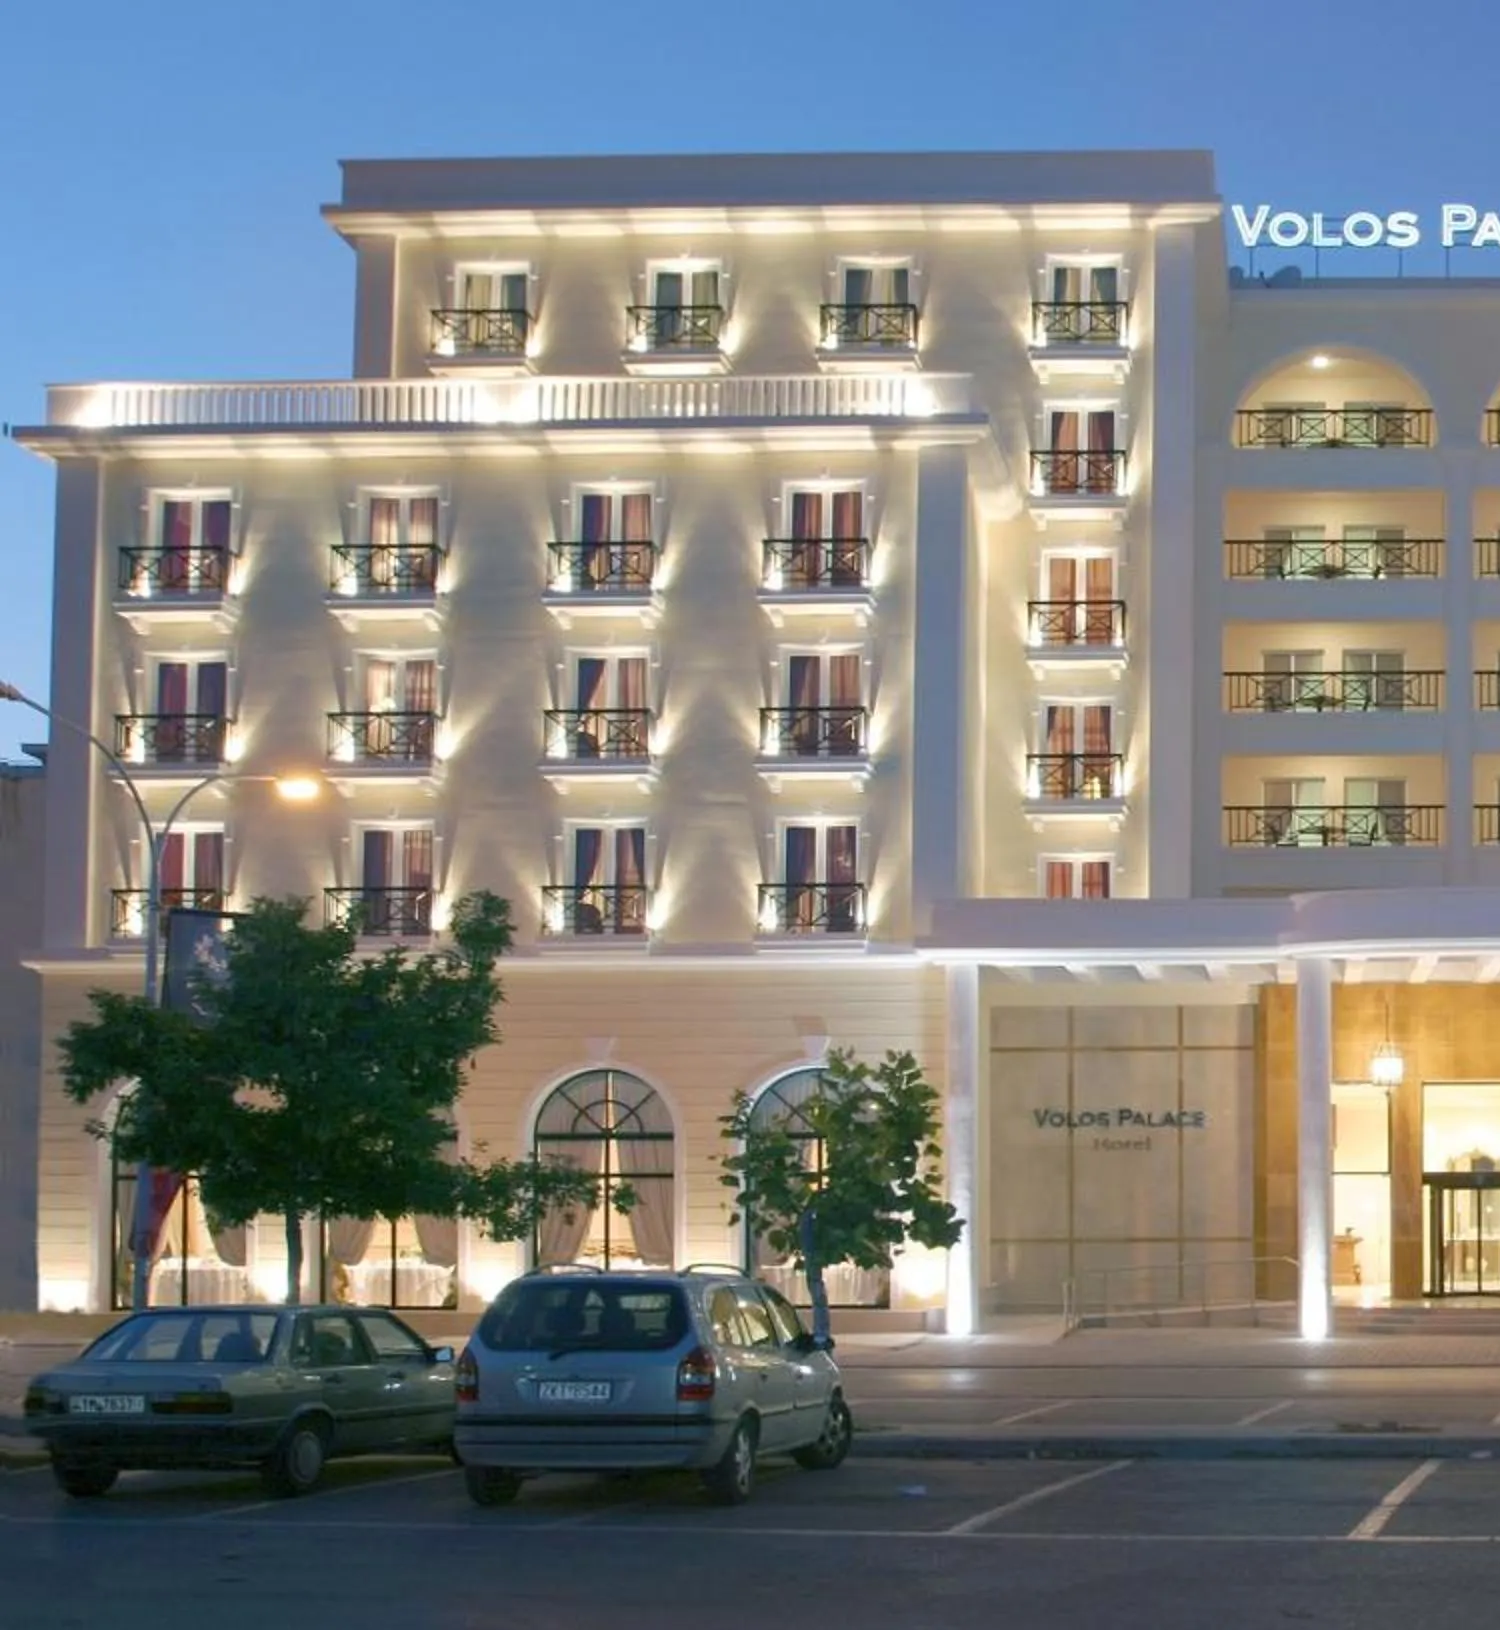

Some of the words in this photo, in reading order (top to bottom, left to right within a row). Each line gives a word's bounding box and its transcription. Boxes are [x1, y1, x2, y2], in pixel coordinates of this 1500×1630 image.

[1231, 204, 1420, 248] VOLOS
[1033, 1108, 1111, 1129] VOLOS
[1118, 1107, 1206, 1128] PALACE
